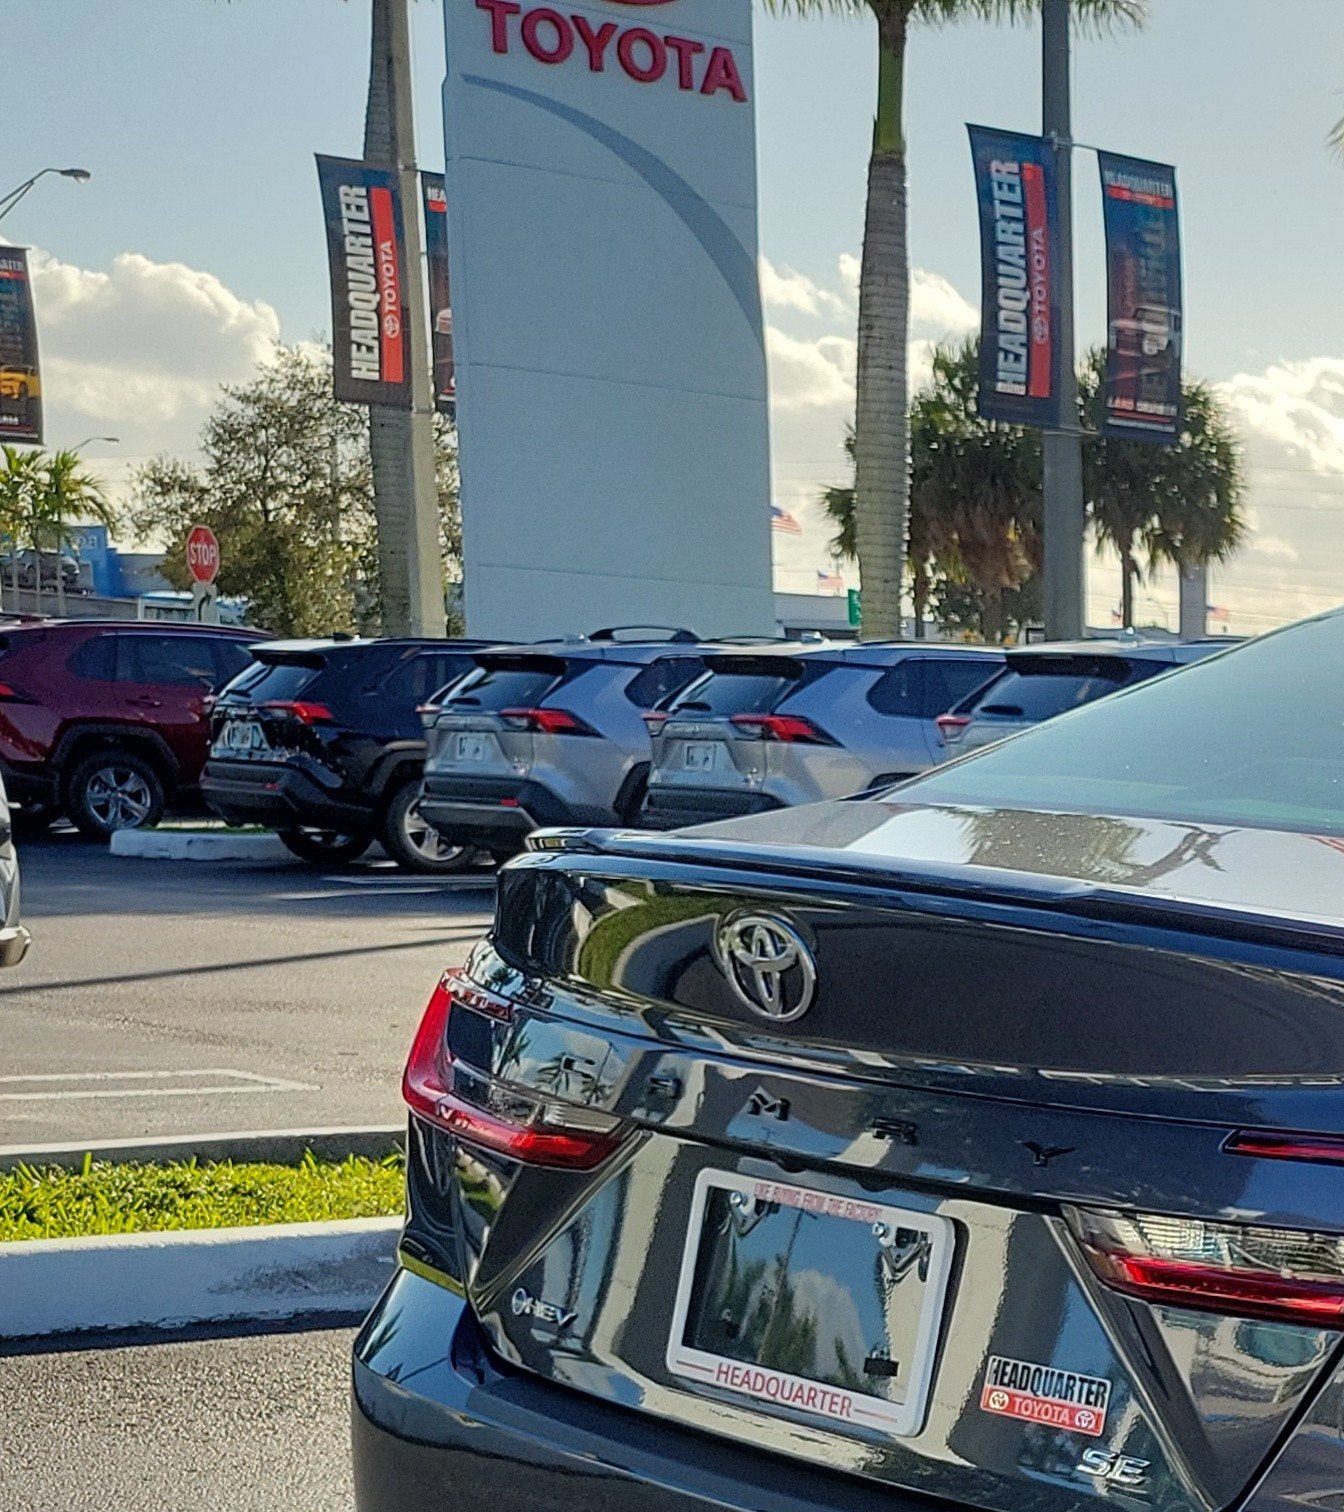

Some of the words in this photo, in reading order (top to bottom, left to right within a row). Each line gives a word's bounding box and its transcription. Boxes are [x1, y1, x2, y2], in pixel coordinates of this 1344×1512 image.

[475, 0, 747, 103] TOYOTA
[339, 184, 380, 382] HEADQUARTER
[380, 241, 397, 312] TOYOTA
[991, 159, 1030, 396] HEADQUARTER
[1030, 227, 1048, 315] TOYOTA
[189, 543, 217, 566] STOP
[561, 1055, 1077, 1168] CAMRY
[524, 1297, 578, 1327] HEV
[715, 1362, 853, 1418] HEADQUARTER
[988, 1357, 1107, 1409] HEADQUARTER
[1013, 1396, 1070, 1425] TOYOTA
[1076, 1448, 1150, 1484] SE
